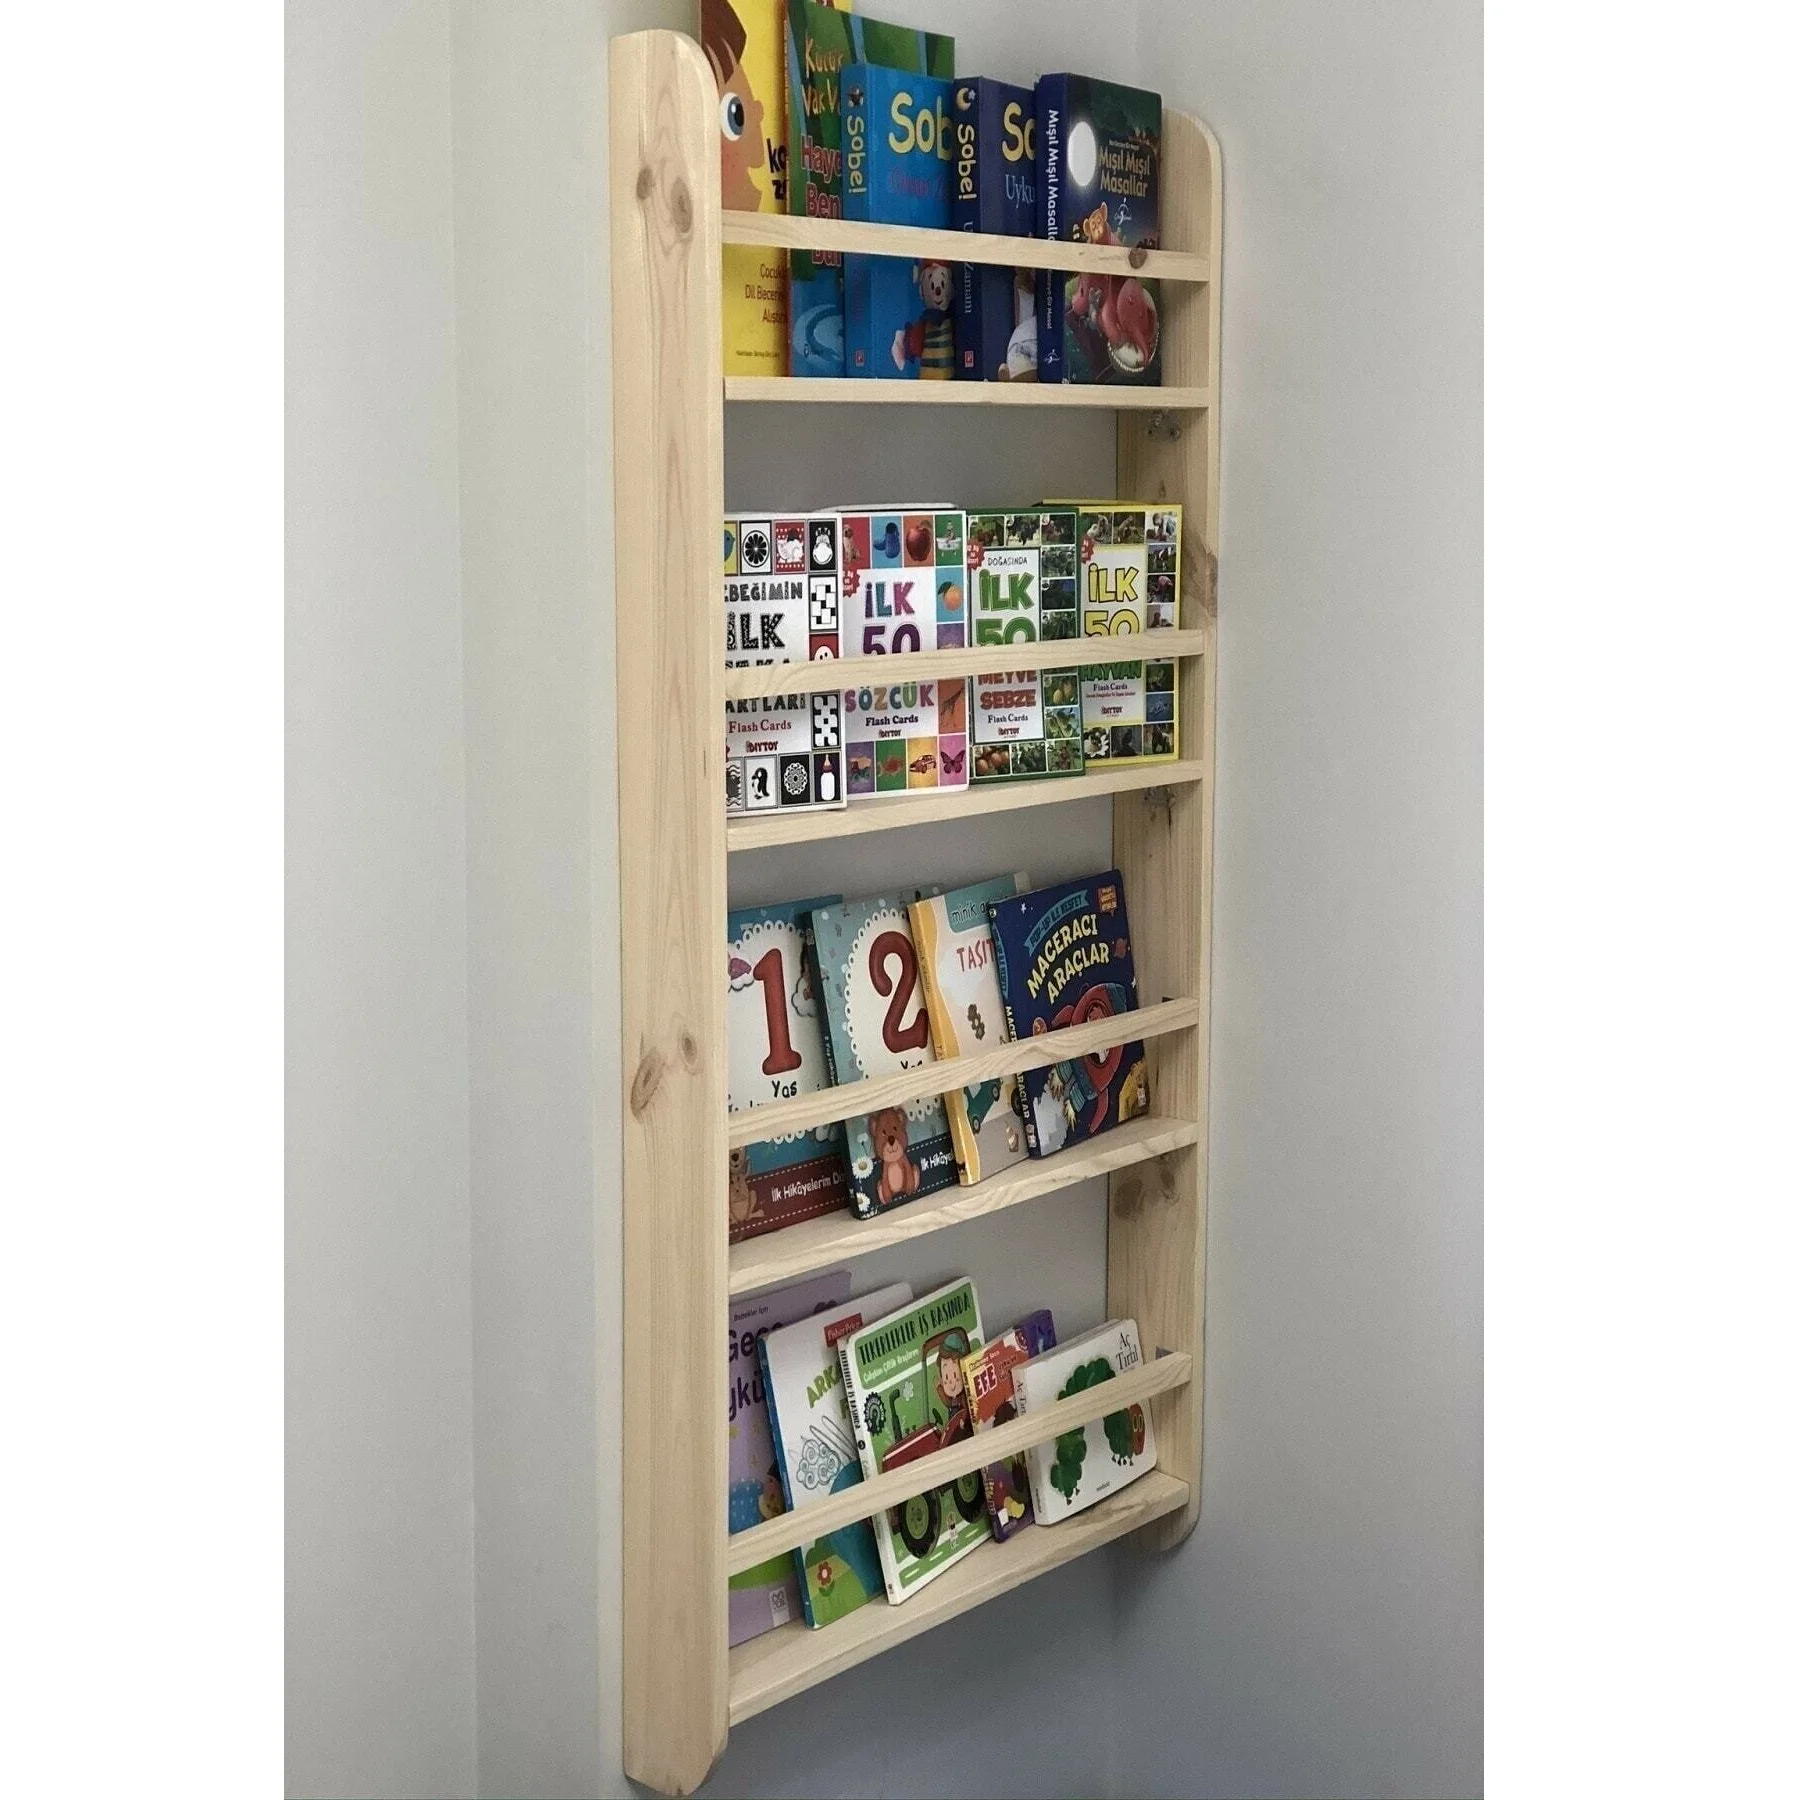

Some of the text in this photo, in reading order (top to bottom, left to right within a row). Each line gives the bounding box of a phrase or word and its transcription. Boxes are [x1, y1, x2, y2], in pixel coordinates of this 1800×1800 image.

[1100, 168, 1149, 198] Masallar
[975, 616, 1037, 648] 50
[1084, 608, 1140, 638] 50
[862, 623, 922, 657] 50
[980, 689, 1037, 711] SEBZE
[1093, 682, 1128, 691] Flash Cards
[728, 719, 792, 734] Flash Cards
[865, 714, 919, 727] Flash Cards
[988, 713, 1029, 724] Flash Cards
[951, 901, 978, 923] minik
[1027, 913, 1098, 1000] MACERACI
[1047, 942, 1110, 1005] ARAÇLAR
[869, 930, 929, 1054] 2
[753, 948, 802, 1076] 1
[859, 1320, 918, 1366] TEKERLEKLER
[930, 1291, 971, 1328] BAŞINDA
